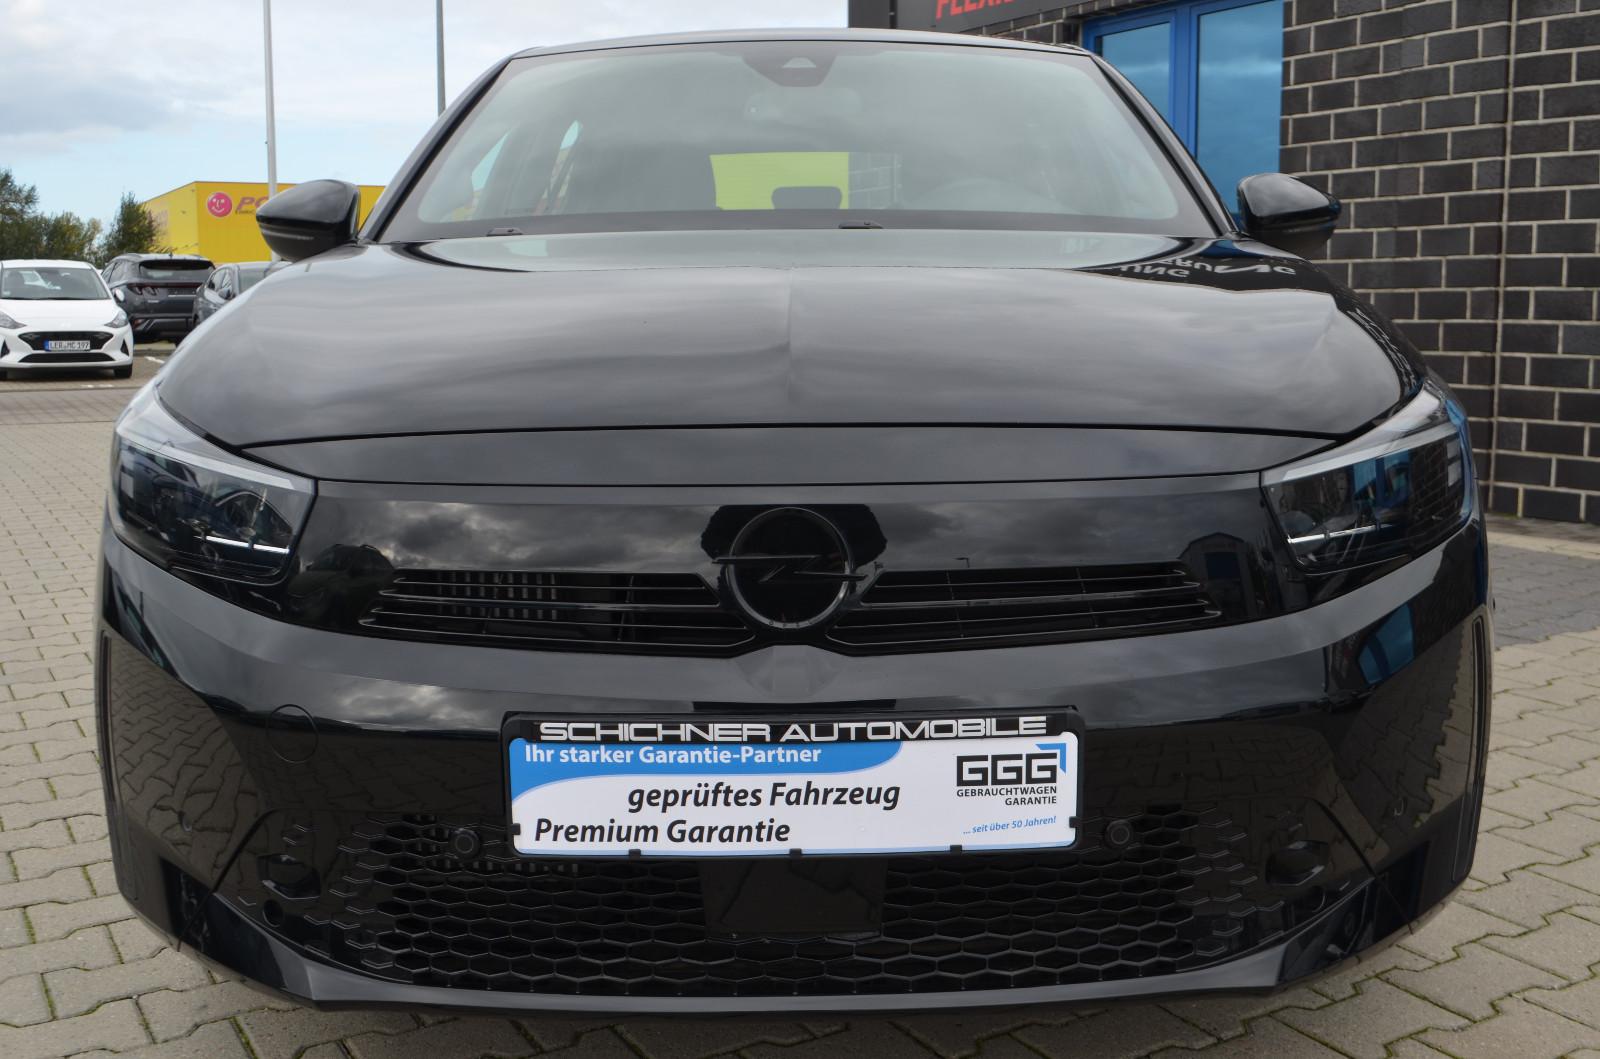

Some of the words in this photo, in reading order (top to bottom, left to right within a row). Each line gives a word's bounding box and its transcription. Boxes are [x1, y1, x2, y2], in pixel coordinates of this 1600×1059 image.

[540, 722, 770, 742] SCHICHNER
[780, 716, 1047, 742] AUTOMOBILE
[525, 744, 554, 763] Ihr
[559, 744, 634, 763] starker
[638, 745, 821, 764] Garantie-Partner
[956, 752, 1058, 787] GGG
[628, 782, 762, 813] geprüftes
[770, 781, 901, 811] Fahrzeug
[956, 786, 1058, 798] GEBRAUCHTWAGEN
[1005, 796, 1058, 806] GARANTIE
[534, 818, 659, 843] Premium
[667, 818, 791, 843] Garantie
[972, 823, 988, 834] seit
[989, 820, 1010, 833] über
[1011, 819, 1023, 829] 50
[1024, 815, 1057, 828] Jahren!
